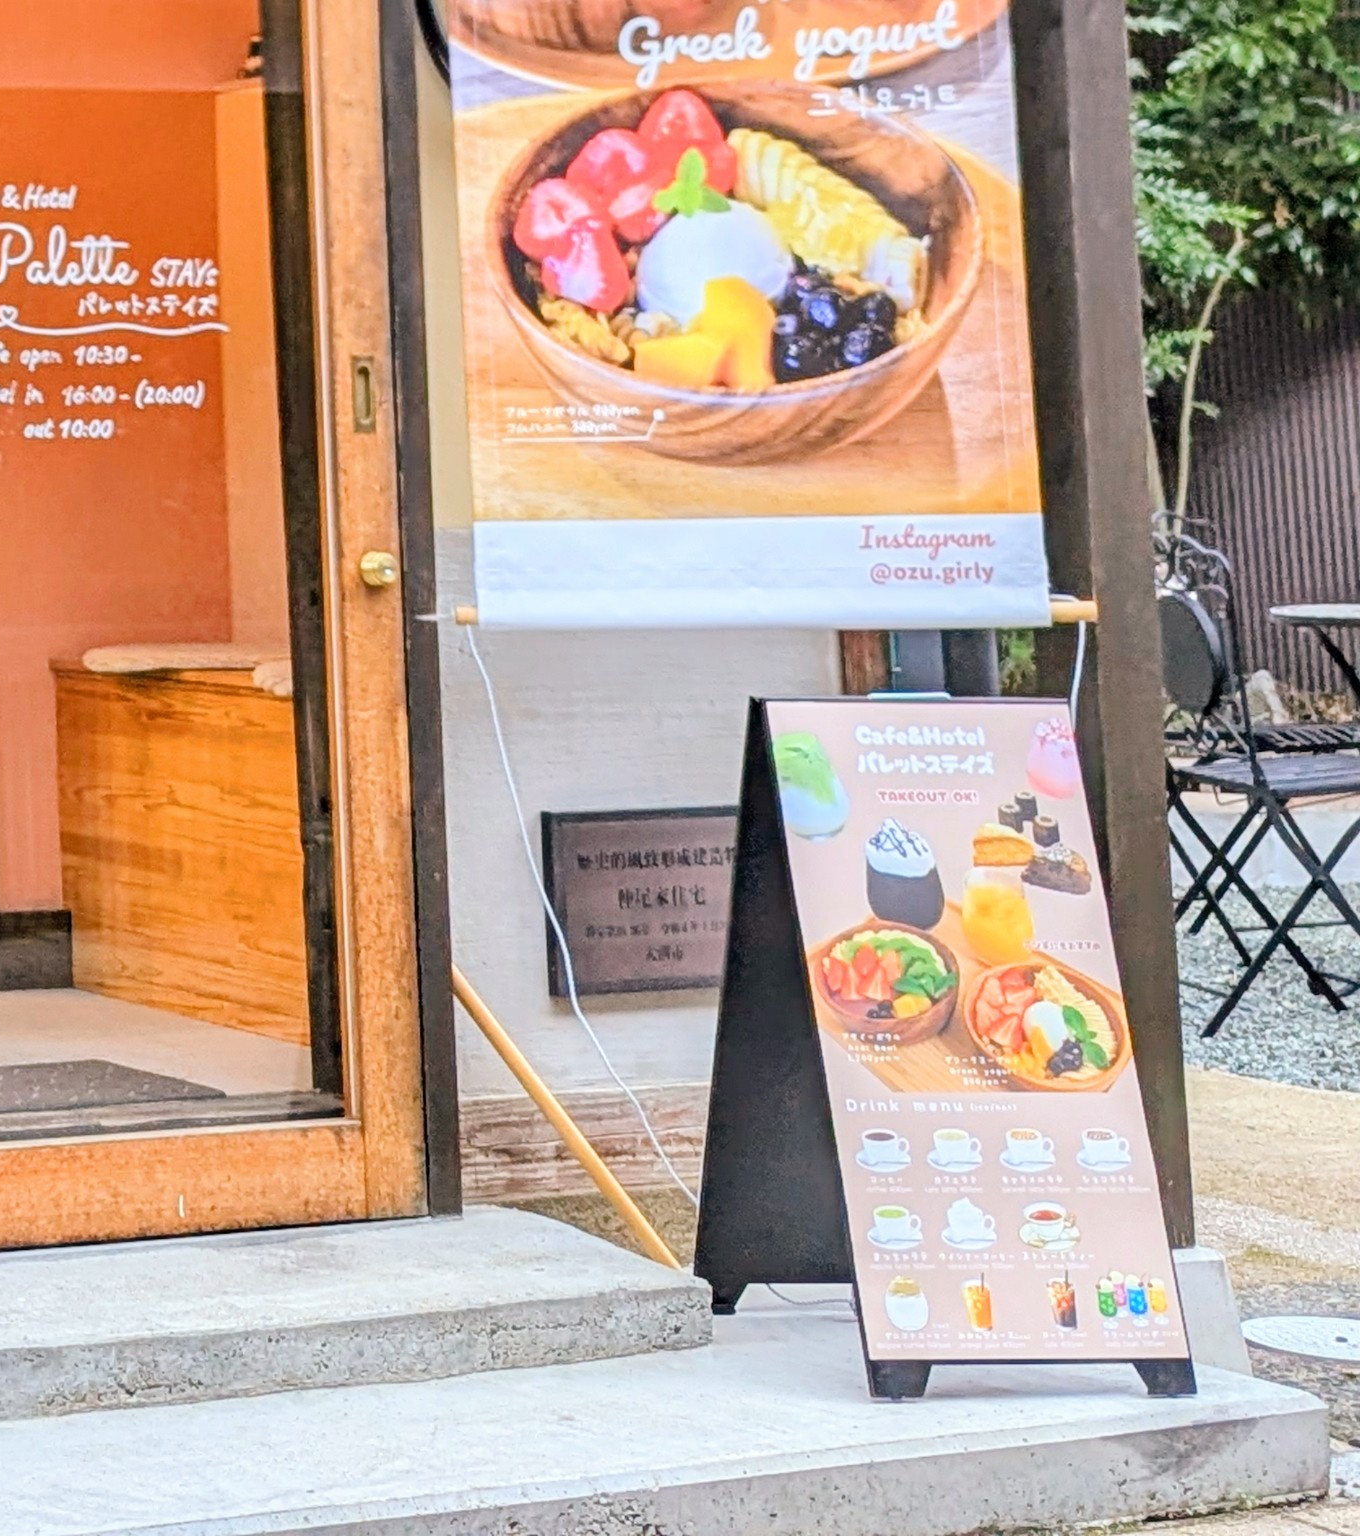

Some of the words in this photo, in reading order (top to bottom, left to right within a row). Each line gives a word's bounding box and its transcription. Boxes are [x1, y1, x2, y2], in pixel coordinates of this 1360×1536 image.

[618, 5, 774, 90] Greek
[0, 183, 22, 210] &
[23, 182, 78, 211] Hotel
[77, 291, 219, 317] パレットステイズ
[19, 348, 63, 372] open
[23, 384, 44, 406] in
[23, 418, 55, 440] out
[58, 418, 115, 440] 10:00
[858, 522, 996, 561] Instagram
[870, 561, 994, 585] @ozu.girly
[854, 724, 987, 748] Cafe&Hotel
[858, 752, 995, 775] パレットステイズ
[878, 791, 948, 803] TAKEOUT
[846, 1098, 901, 1113] Drink
[913, 1102, 963, 1112] menu
